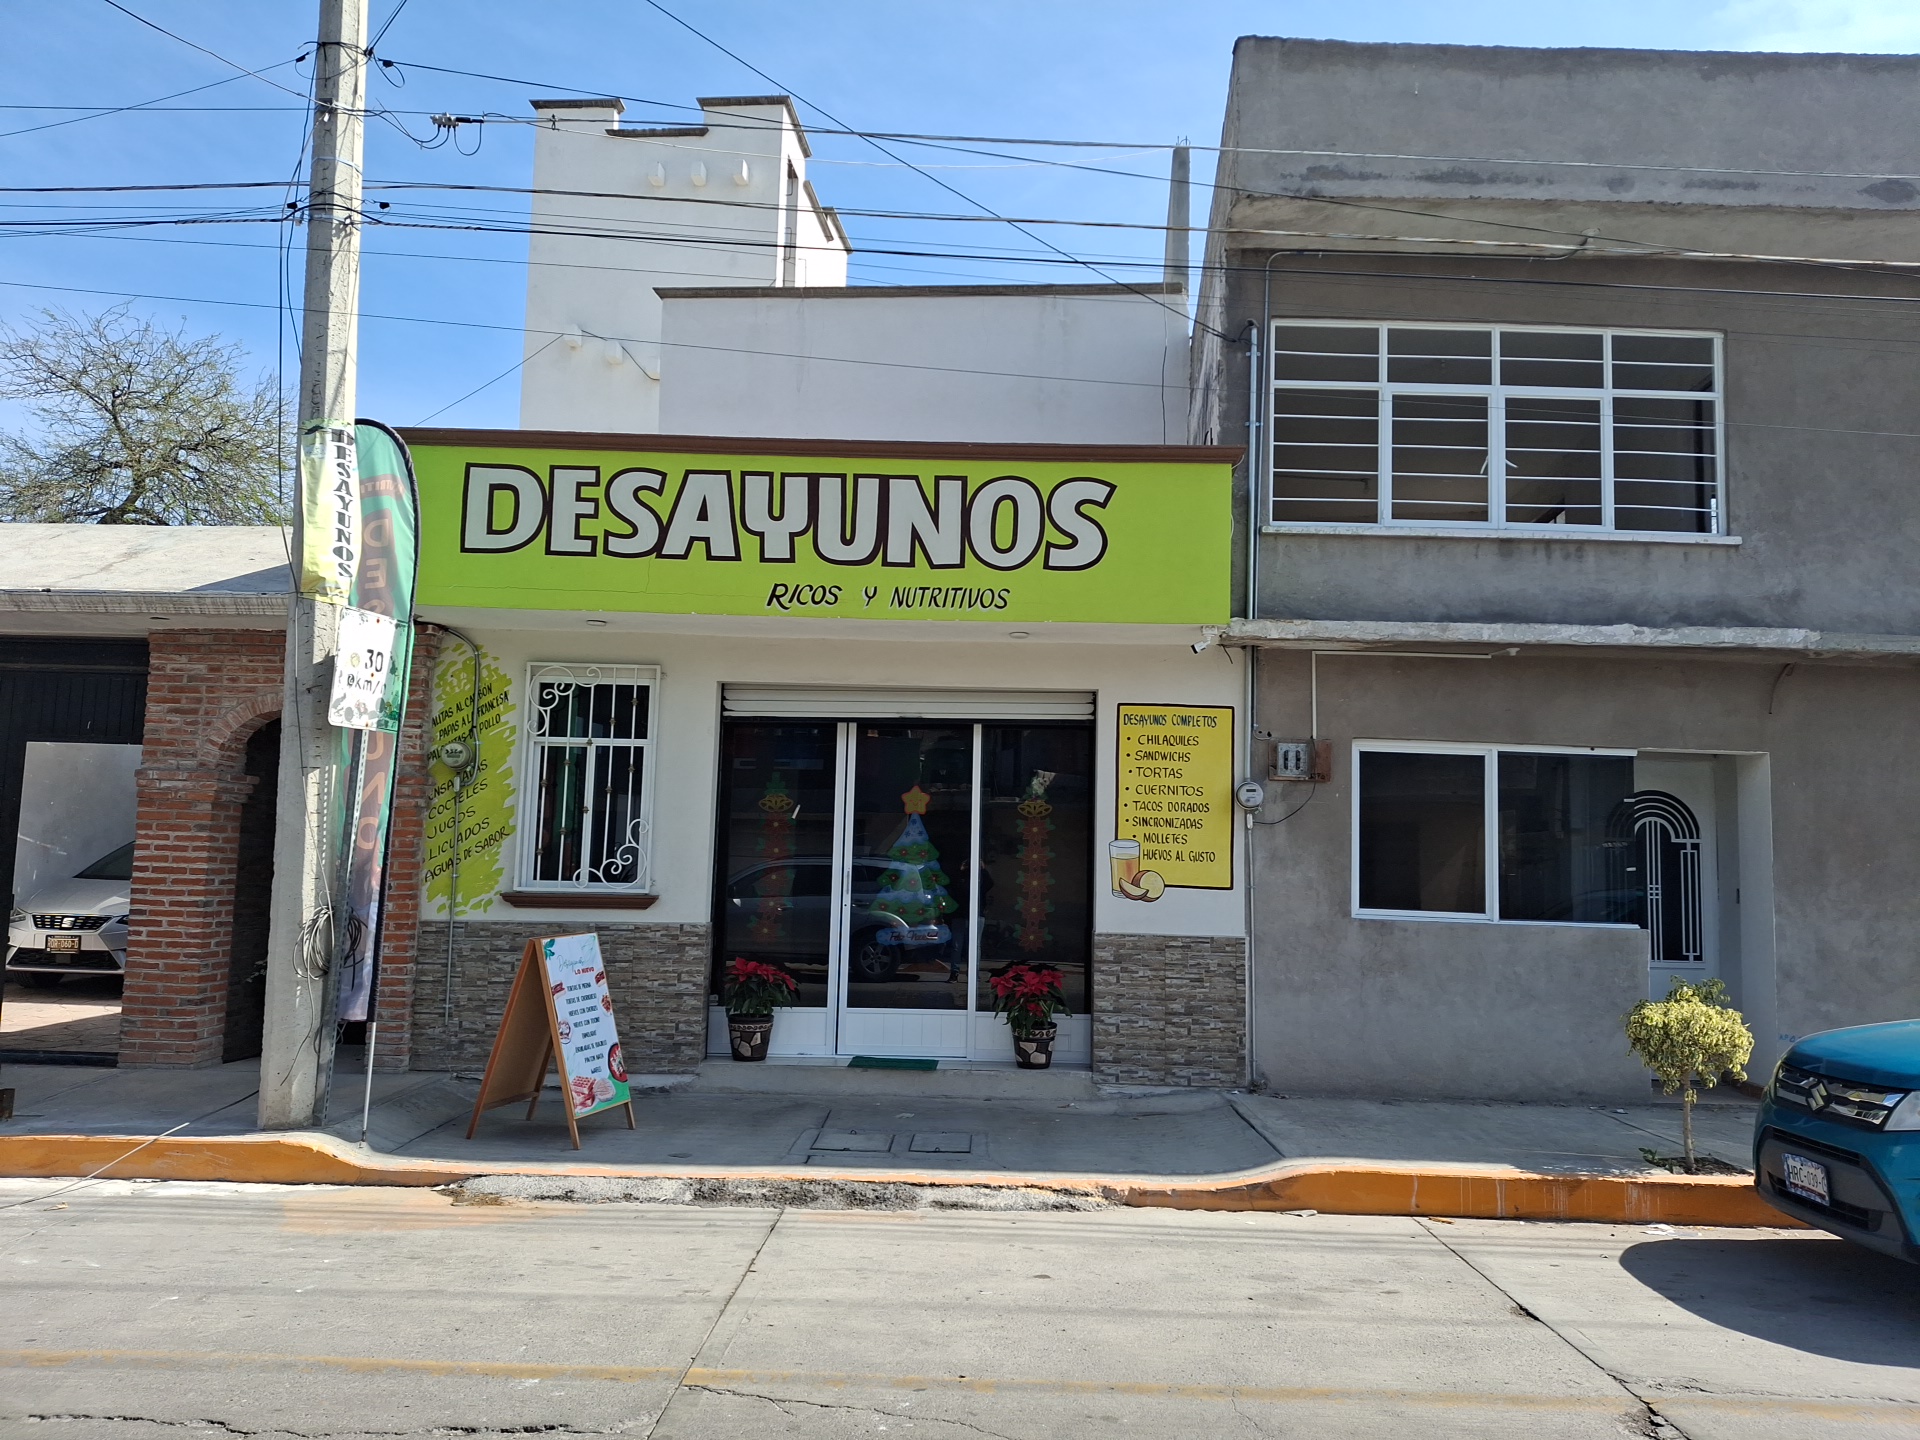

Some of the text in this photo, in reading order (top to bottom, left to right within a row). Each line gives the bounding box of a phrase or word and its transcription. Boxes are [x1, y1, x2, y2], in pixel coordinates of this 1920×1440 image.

[330, 428, 356, 579] DESAYUNOS
[460, 462, 1118, 572] DESAYUNOS
[767, 582, 1011, 611] RICOS Y NUTRITIVOS
[364, 648, 384, 672] 30
[456, 702, 464, 714] AL
[438, 720, 459, 741] PAPAS
[461, 717, 467, 729] A
[479, 713, 501, 734] POLLO
[1123, 713, 1218, 729] DESAYUNOS COMPLETOS
[1137, 734, 1200, 747] CHILAQUILES
[1134, 749, 1191, 763] SANDWICHS
[1135, 766, 1183, 779] TORTAS
[428, 778, 489, 820] COCTELES
[1135, 784, 1204, 797] CUERNITOS
[1132, 800, 1210, 813] TACOS DORADOS
[427, 805, 476, 840] JUGOS
[1132, 816, 1204, 830] SINCRONIZADAS
[428, 816, 490, 862] LICUADOS
[1143, 832, 1188, 845] MOLLETES
[424, 825, 511, 883] AGUAS DE SABOR
[1142, 849, 1216, 863] HUEVOS AL GUSTO
